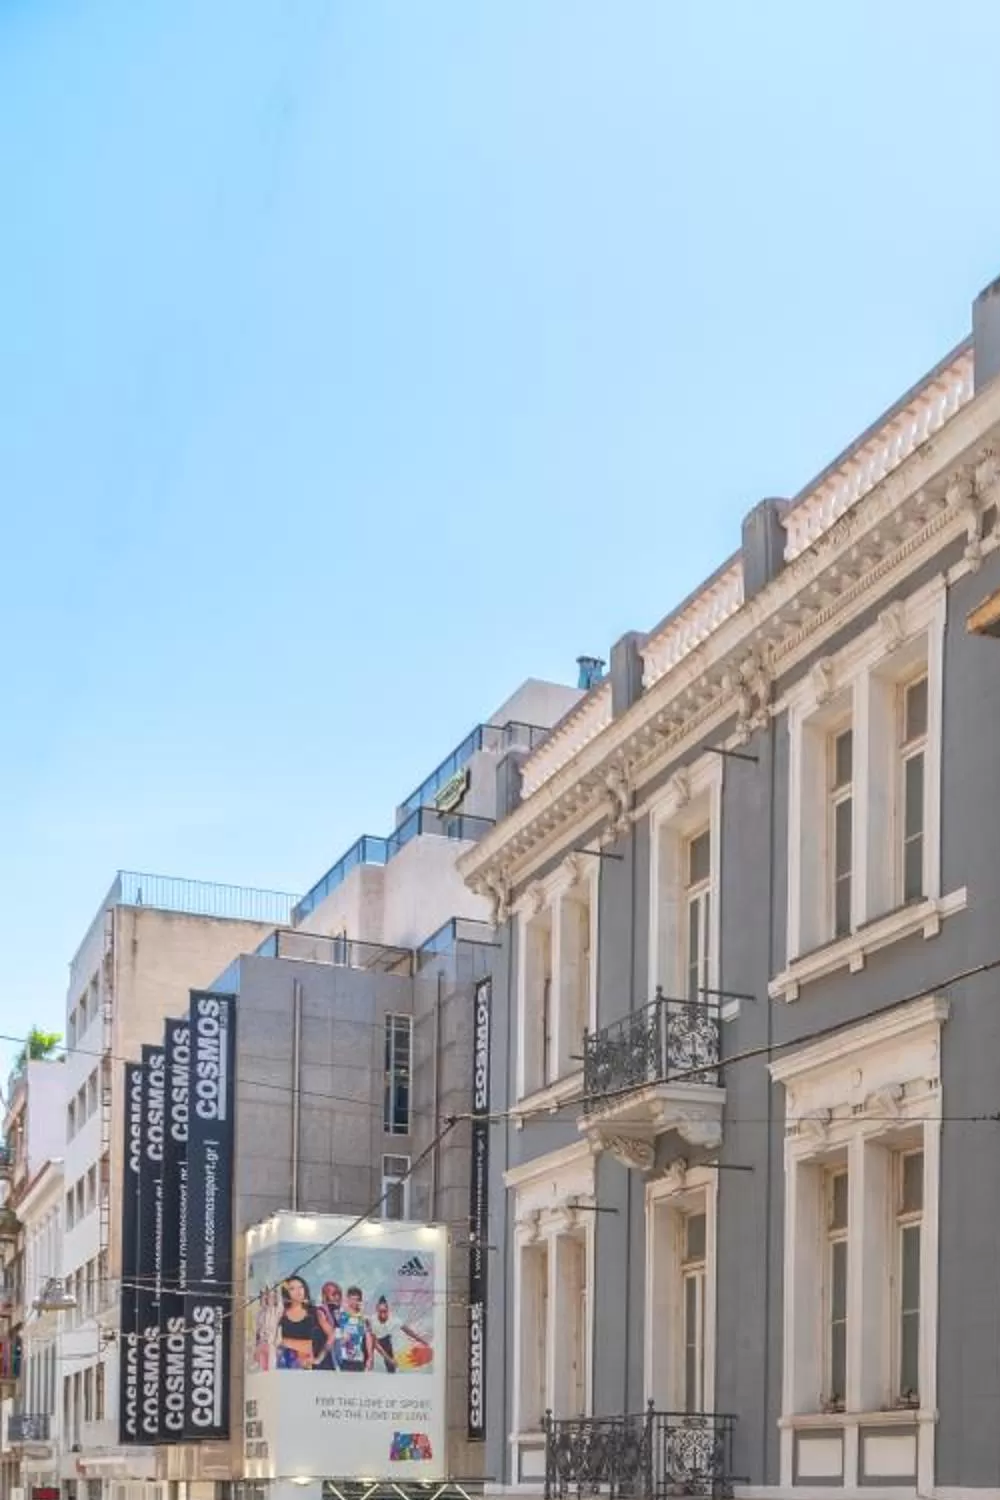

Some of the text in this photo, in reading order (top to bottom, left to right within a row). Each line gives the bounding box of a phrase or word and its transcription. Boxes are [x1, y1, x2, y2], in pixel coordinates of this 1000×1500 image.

[147, 1053, 165, 1161] COSMOS
[171, 1027, 190, 1142] COSMOS
[195, 998, 220, 1120] COSMOS
[143, 1326, 160, 1434] COSMOS
[165, 1316, 186, 1431] COSMOS
[191, 1305, 215, 1427] COSMOS
